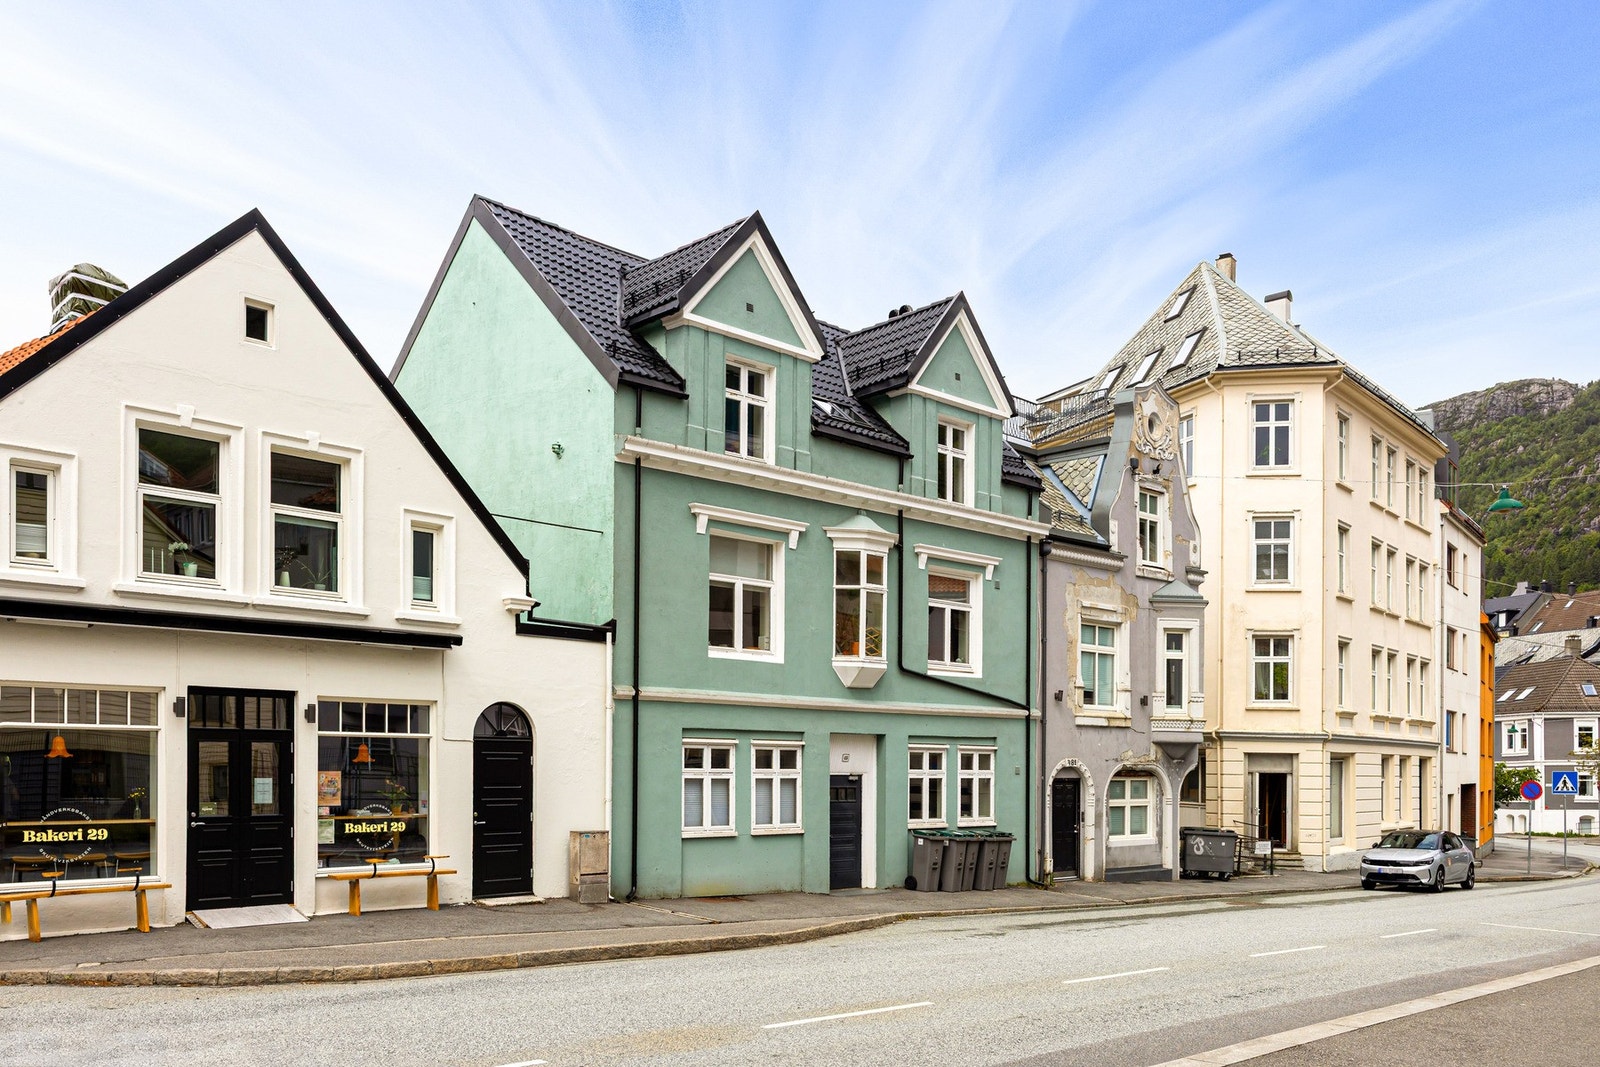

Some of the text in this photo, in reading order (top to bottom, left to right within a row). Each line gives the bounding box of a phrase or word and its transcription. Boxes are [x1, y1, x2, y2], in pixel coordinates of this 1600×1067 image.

[344, 821, 388, 834] Bakeri
[390, 821, 406, 832] 29
[22, 828, 108, 843] Bakeri 29
